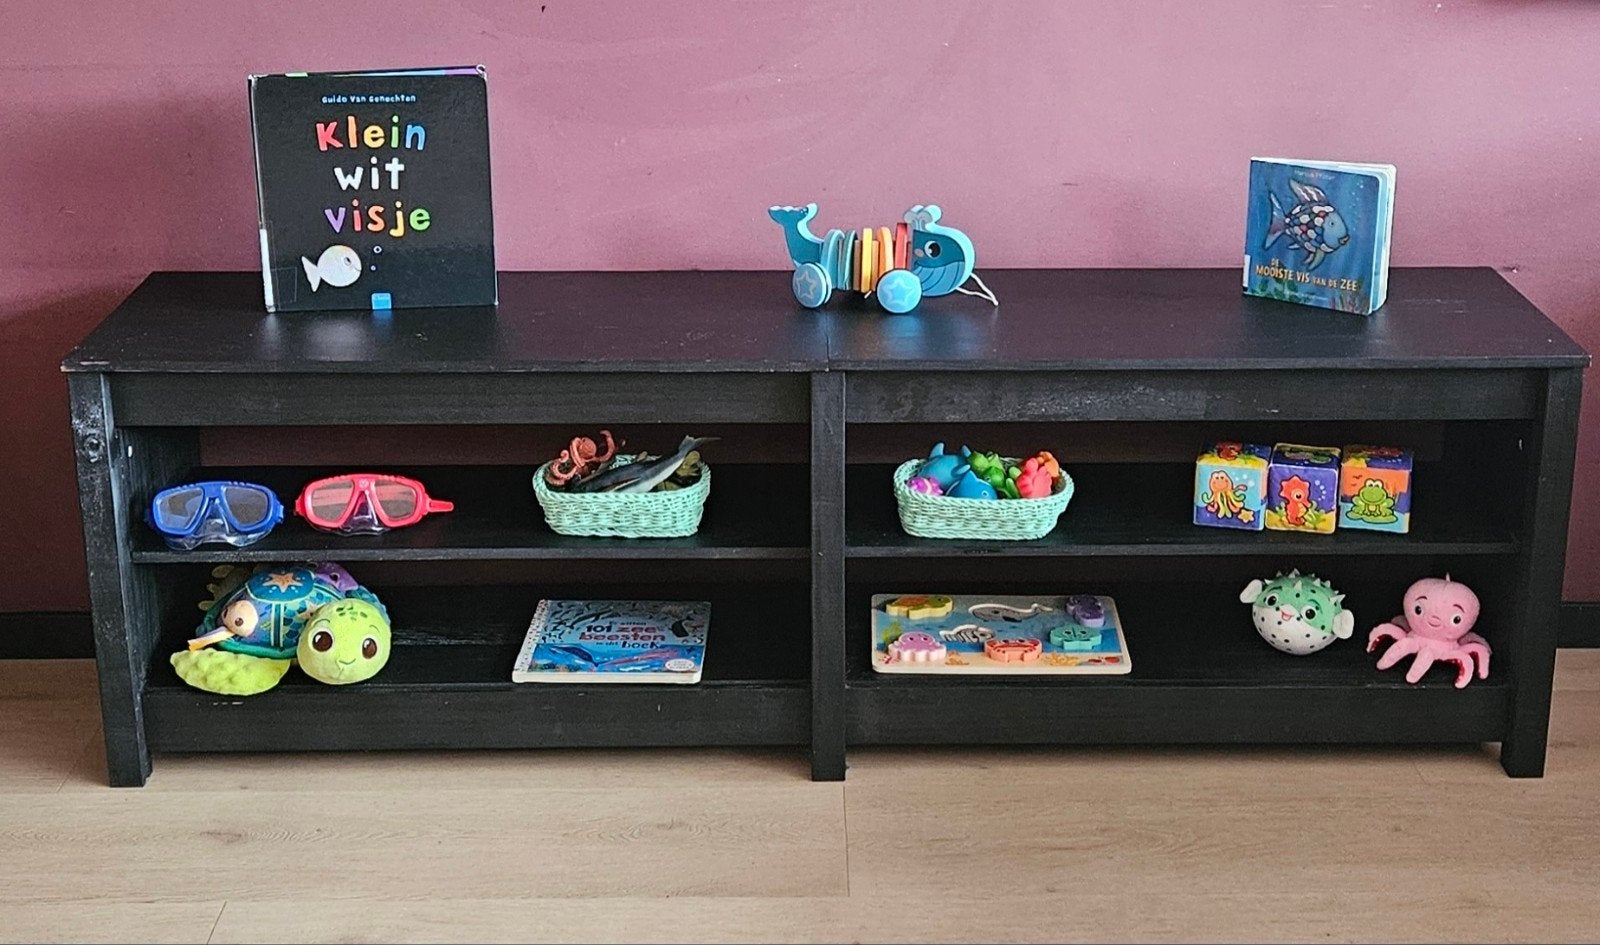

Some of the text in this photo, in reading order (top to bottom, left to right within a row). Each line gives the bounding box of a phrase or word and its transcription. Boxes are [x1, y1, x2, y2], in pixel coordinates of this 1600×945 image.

[322, 95, 348, 104] Guido
[368, 94, 416, 102] Genechten
[316, 115, 425, 151] Klein
[334, 156, 405, 191] wit
[324, 199, 431, 237] visje
[1256, 265, 1357, 291] MOOISTE VIS VAN DE ZEE
[622, 640, 659, 649] boek
